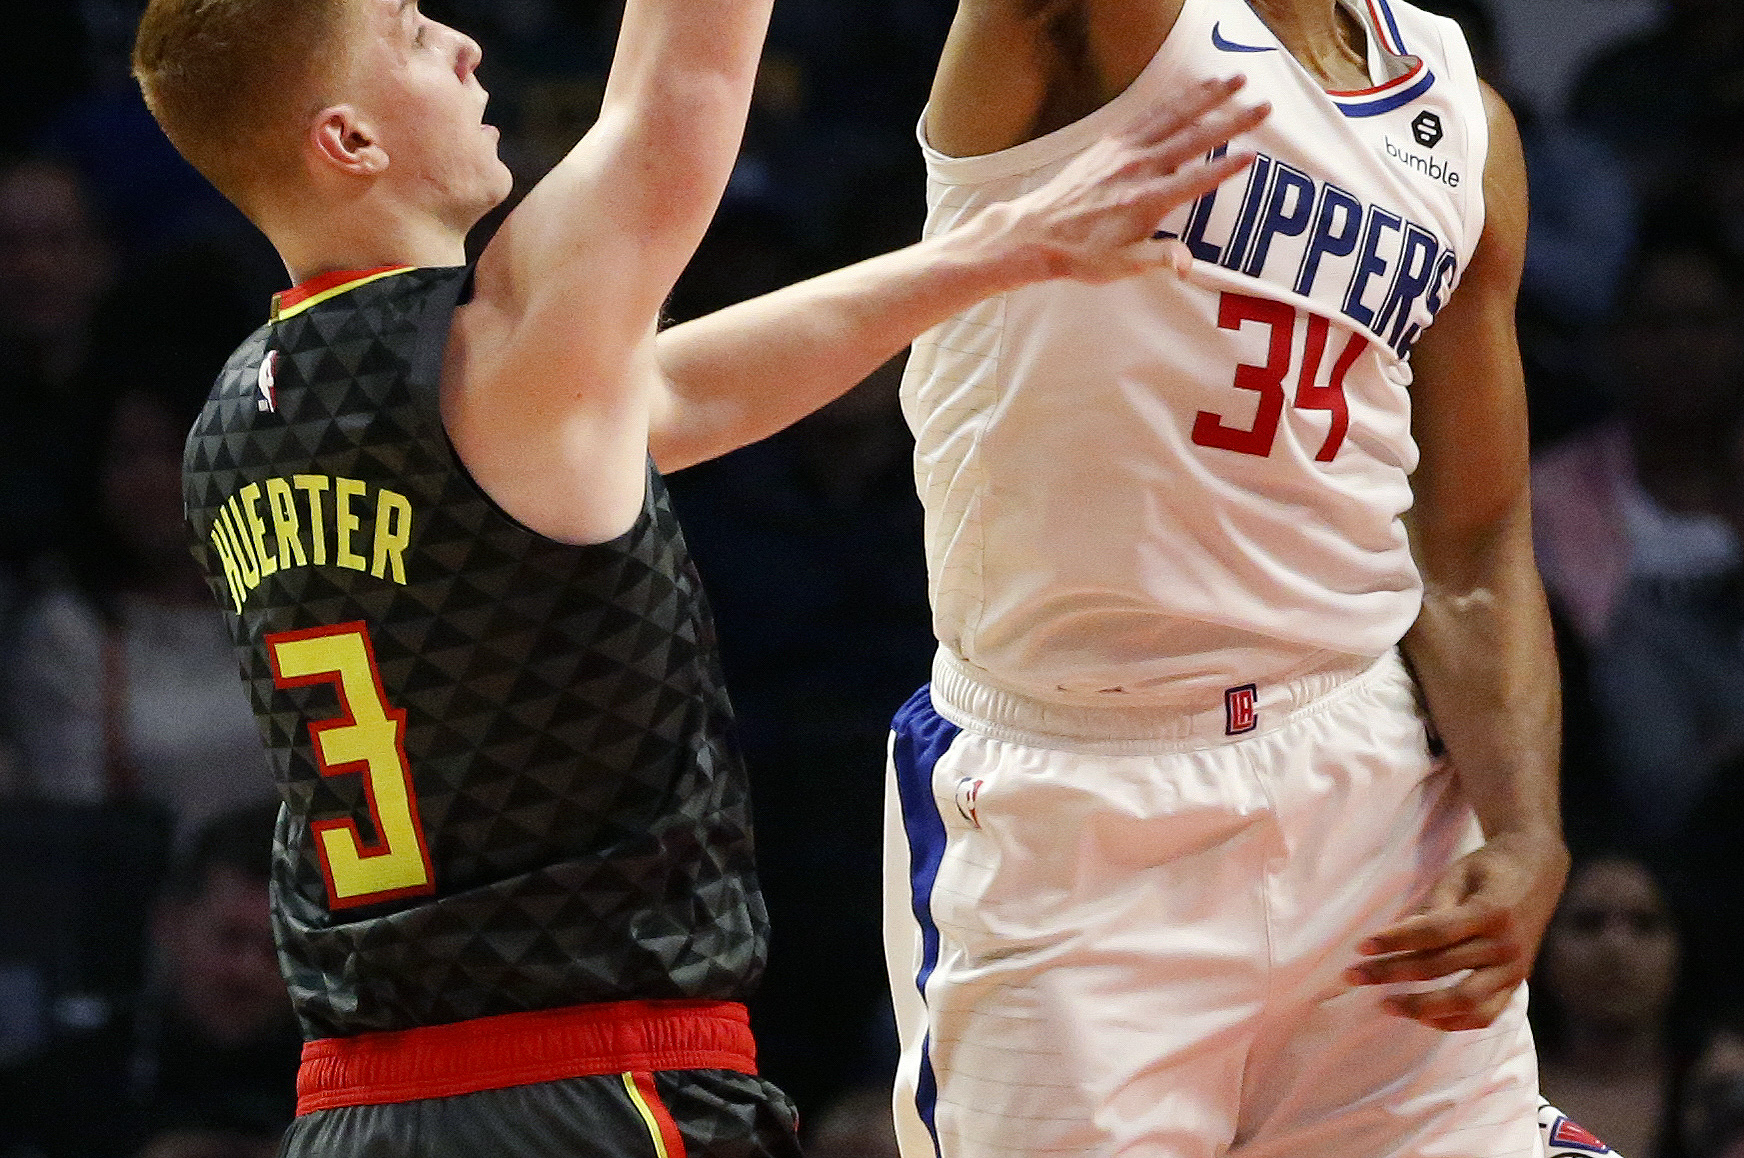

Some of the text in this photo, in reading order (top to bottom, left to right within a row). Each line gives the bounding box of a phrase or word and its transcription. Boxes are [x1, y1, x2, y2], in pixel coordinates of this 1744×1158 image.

[1384, 134, 1460, 188] bumble
[1152, 140, 1457, 360] LIPPERS
[1190, 291, 1369, 463] 34
[210, 473, 413, 616] HUERTER
[264, 619, 437, 910] 3
